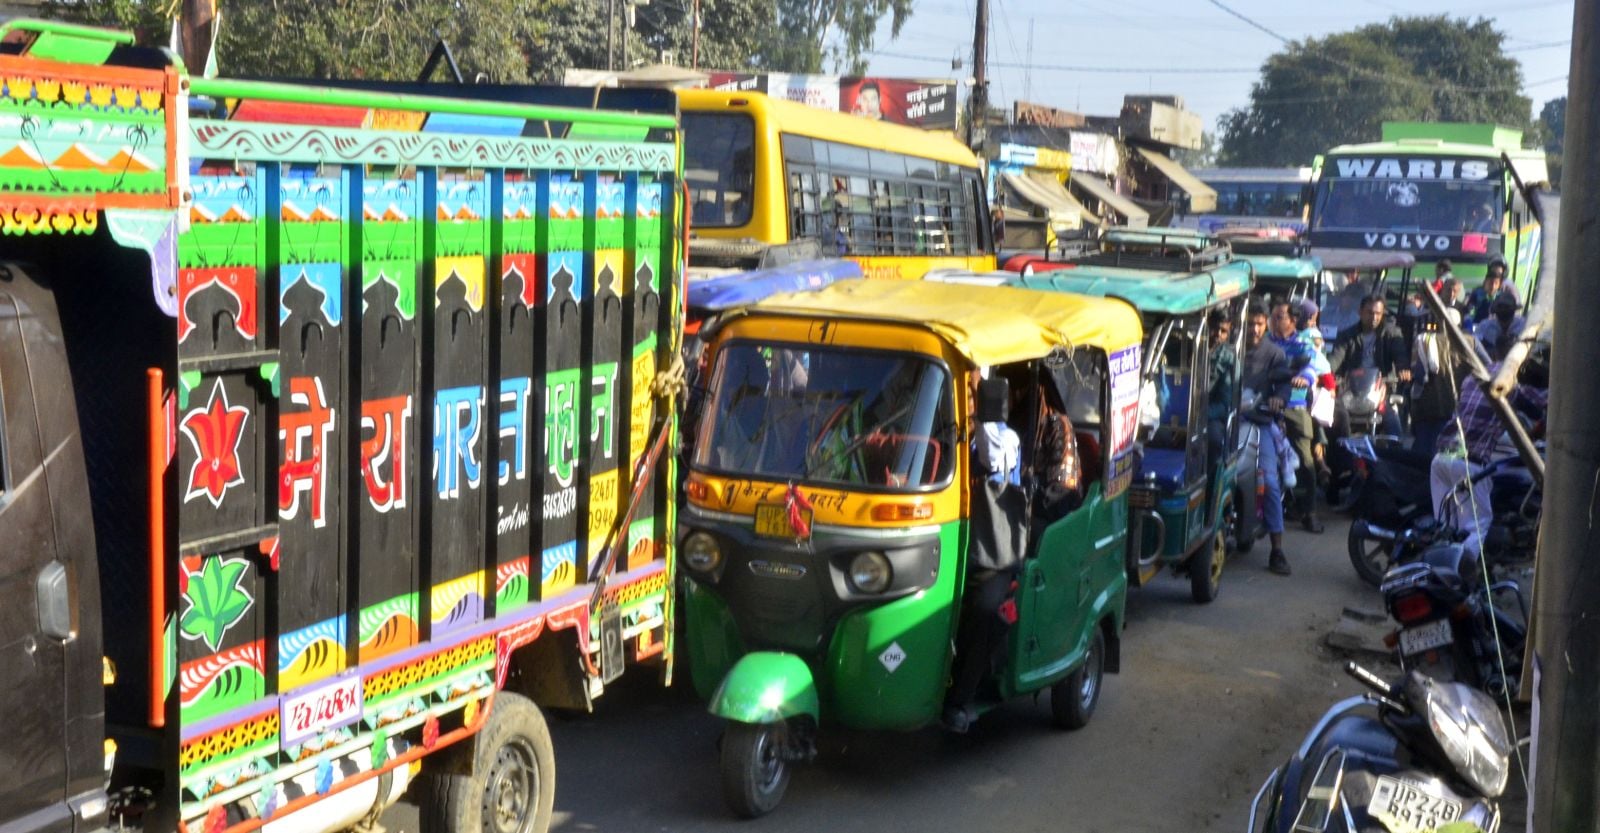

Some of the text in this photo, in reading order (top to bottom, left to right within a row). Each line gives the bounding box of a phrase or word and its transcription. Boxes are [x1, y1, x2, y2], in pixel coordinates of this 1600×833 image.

[1337, 158, 1489, 180] WARIS
[1364, 233, 1450, 250] VOLVO
[884, 653, 901, 663] CNG
